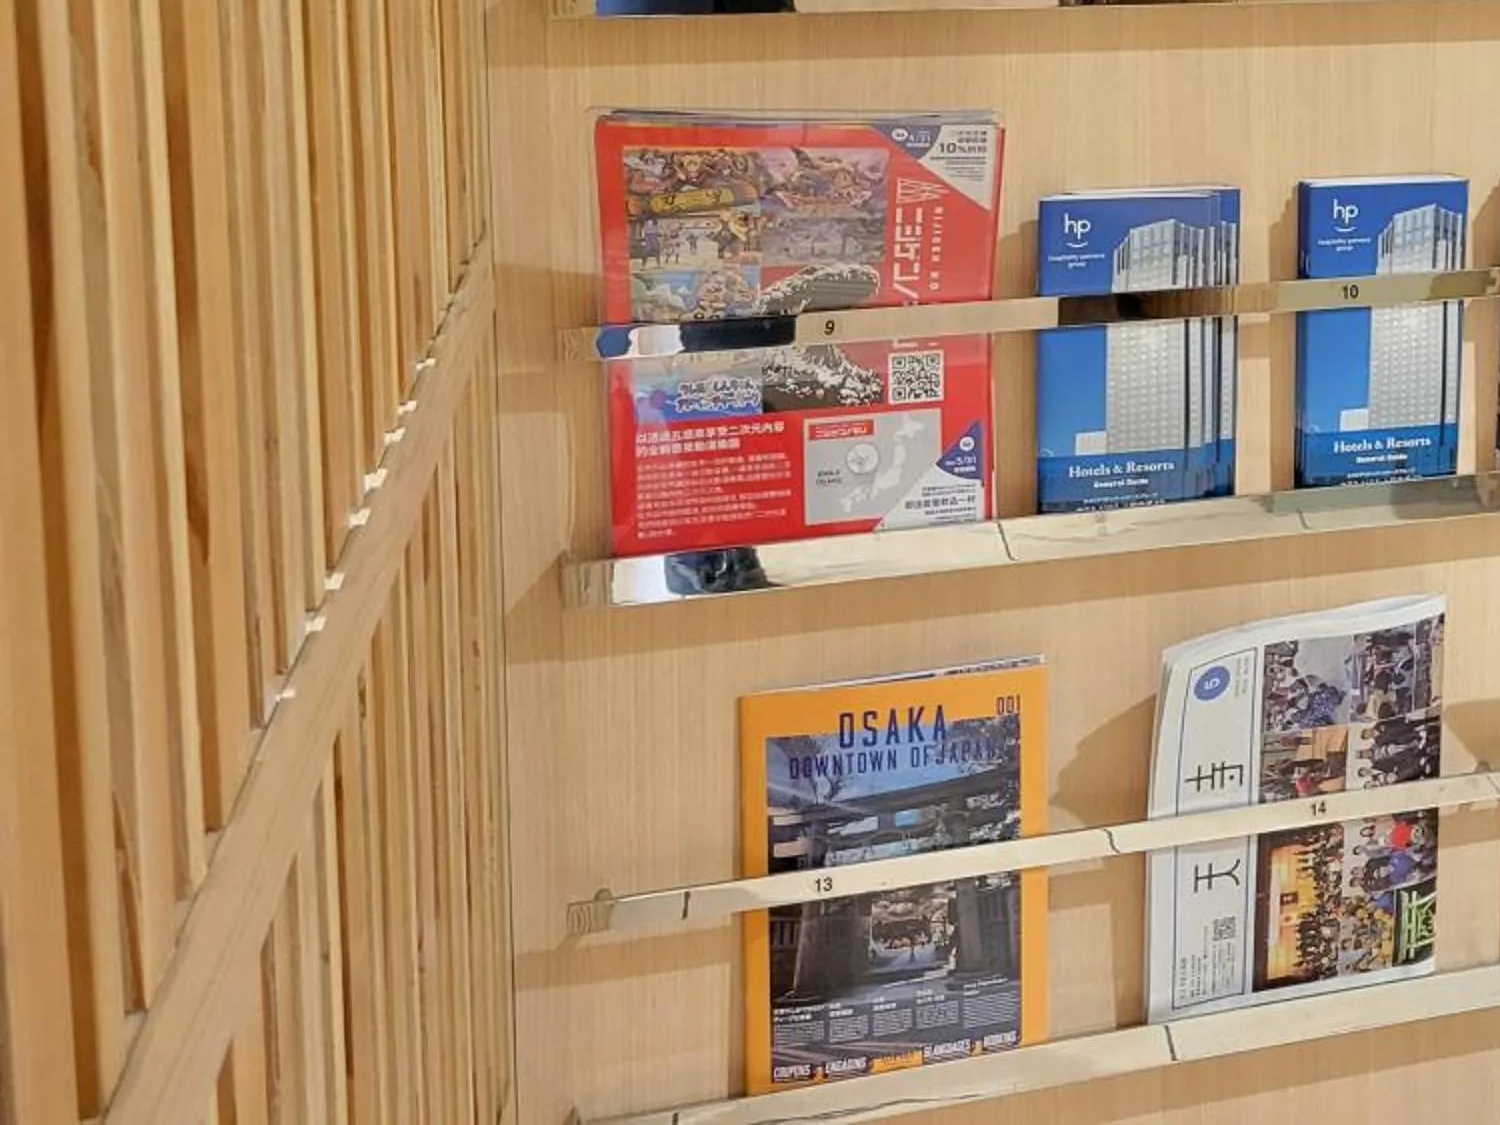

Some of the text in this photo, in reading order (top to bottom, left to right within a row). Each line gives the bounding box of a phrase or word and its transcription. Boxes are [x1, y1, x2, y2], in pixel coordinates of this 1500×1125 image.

[1333, 198, 1359, 225] hp
[1064, 212, 1091, 240] hp
[1342, 284, 1359, 300] 10
[824, 319, 836, 336] 9
[1333, 439, 1373, 454] Hotels
[1386, 437, 1432, 450] Resorts
[1068, 463, 1110, 478] Hotels
[1125, 460, 1175, 473] Resorts
[997, 694, 1021, 715] 001
[839, 704, 947, 749] OSAKA
[789, 739, 997, 780] DOWNTOWN OF JAPAN
[1311, 800, 1327, 816] 14
[814, 877, 833, 893] 13
